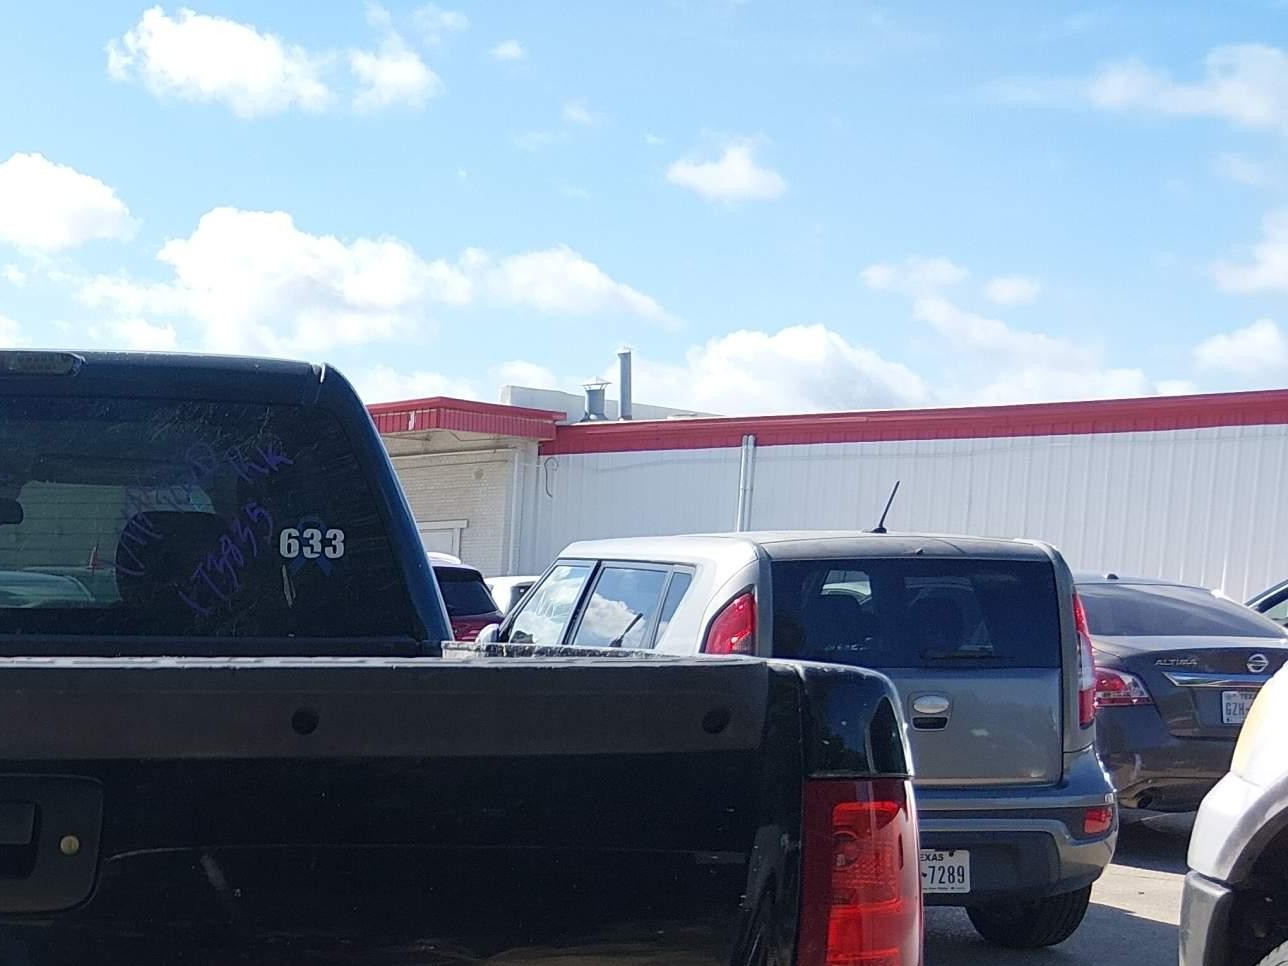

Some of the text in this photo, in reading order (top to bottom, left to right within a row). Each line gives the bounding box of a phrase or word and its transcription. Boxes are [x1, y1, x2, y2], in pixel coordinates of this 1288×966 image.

[280, 528, 345, 559] 633
[920, 853, 945, 862] EXAS
[927, 865, 966, 884] 7289
